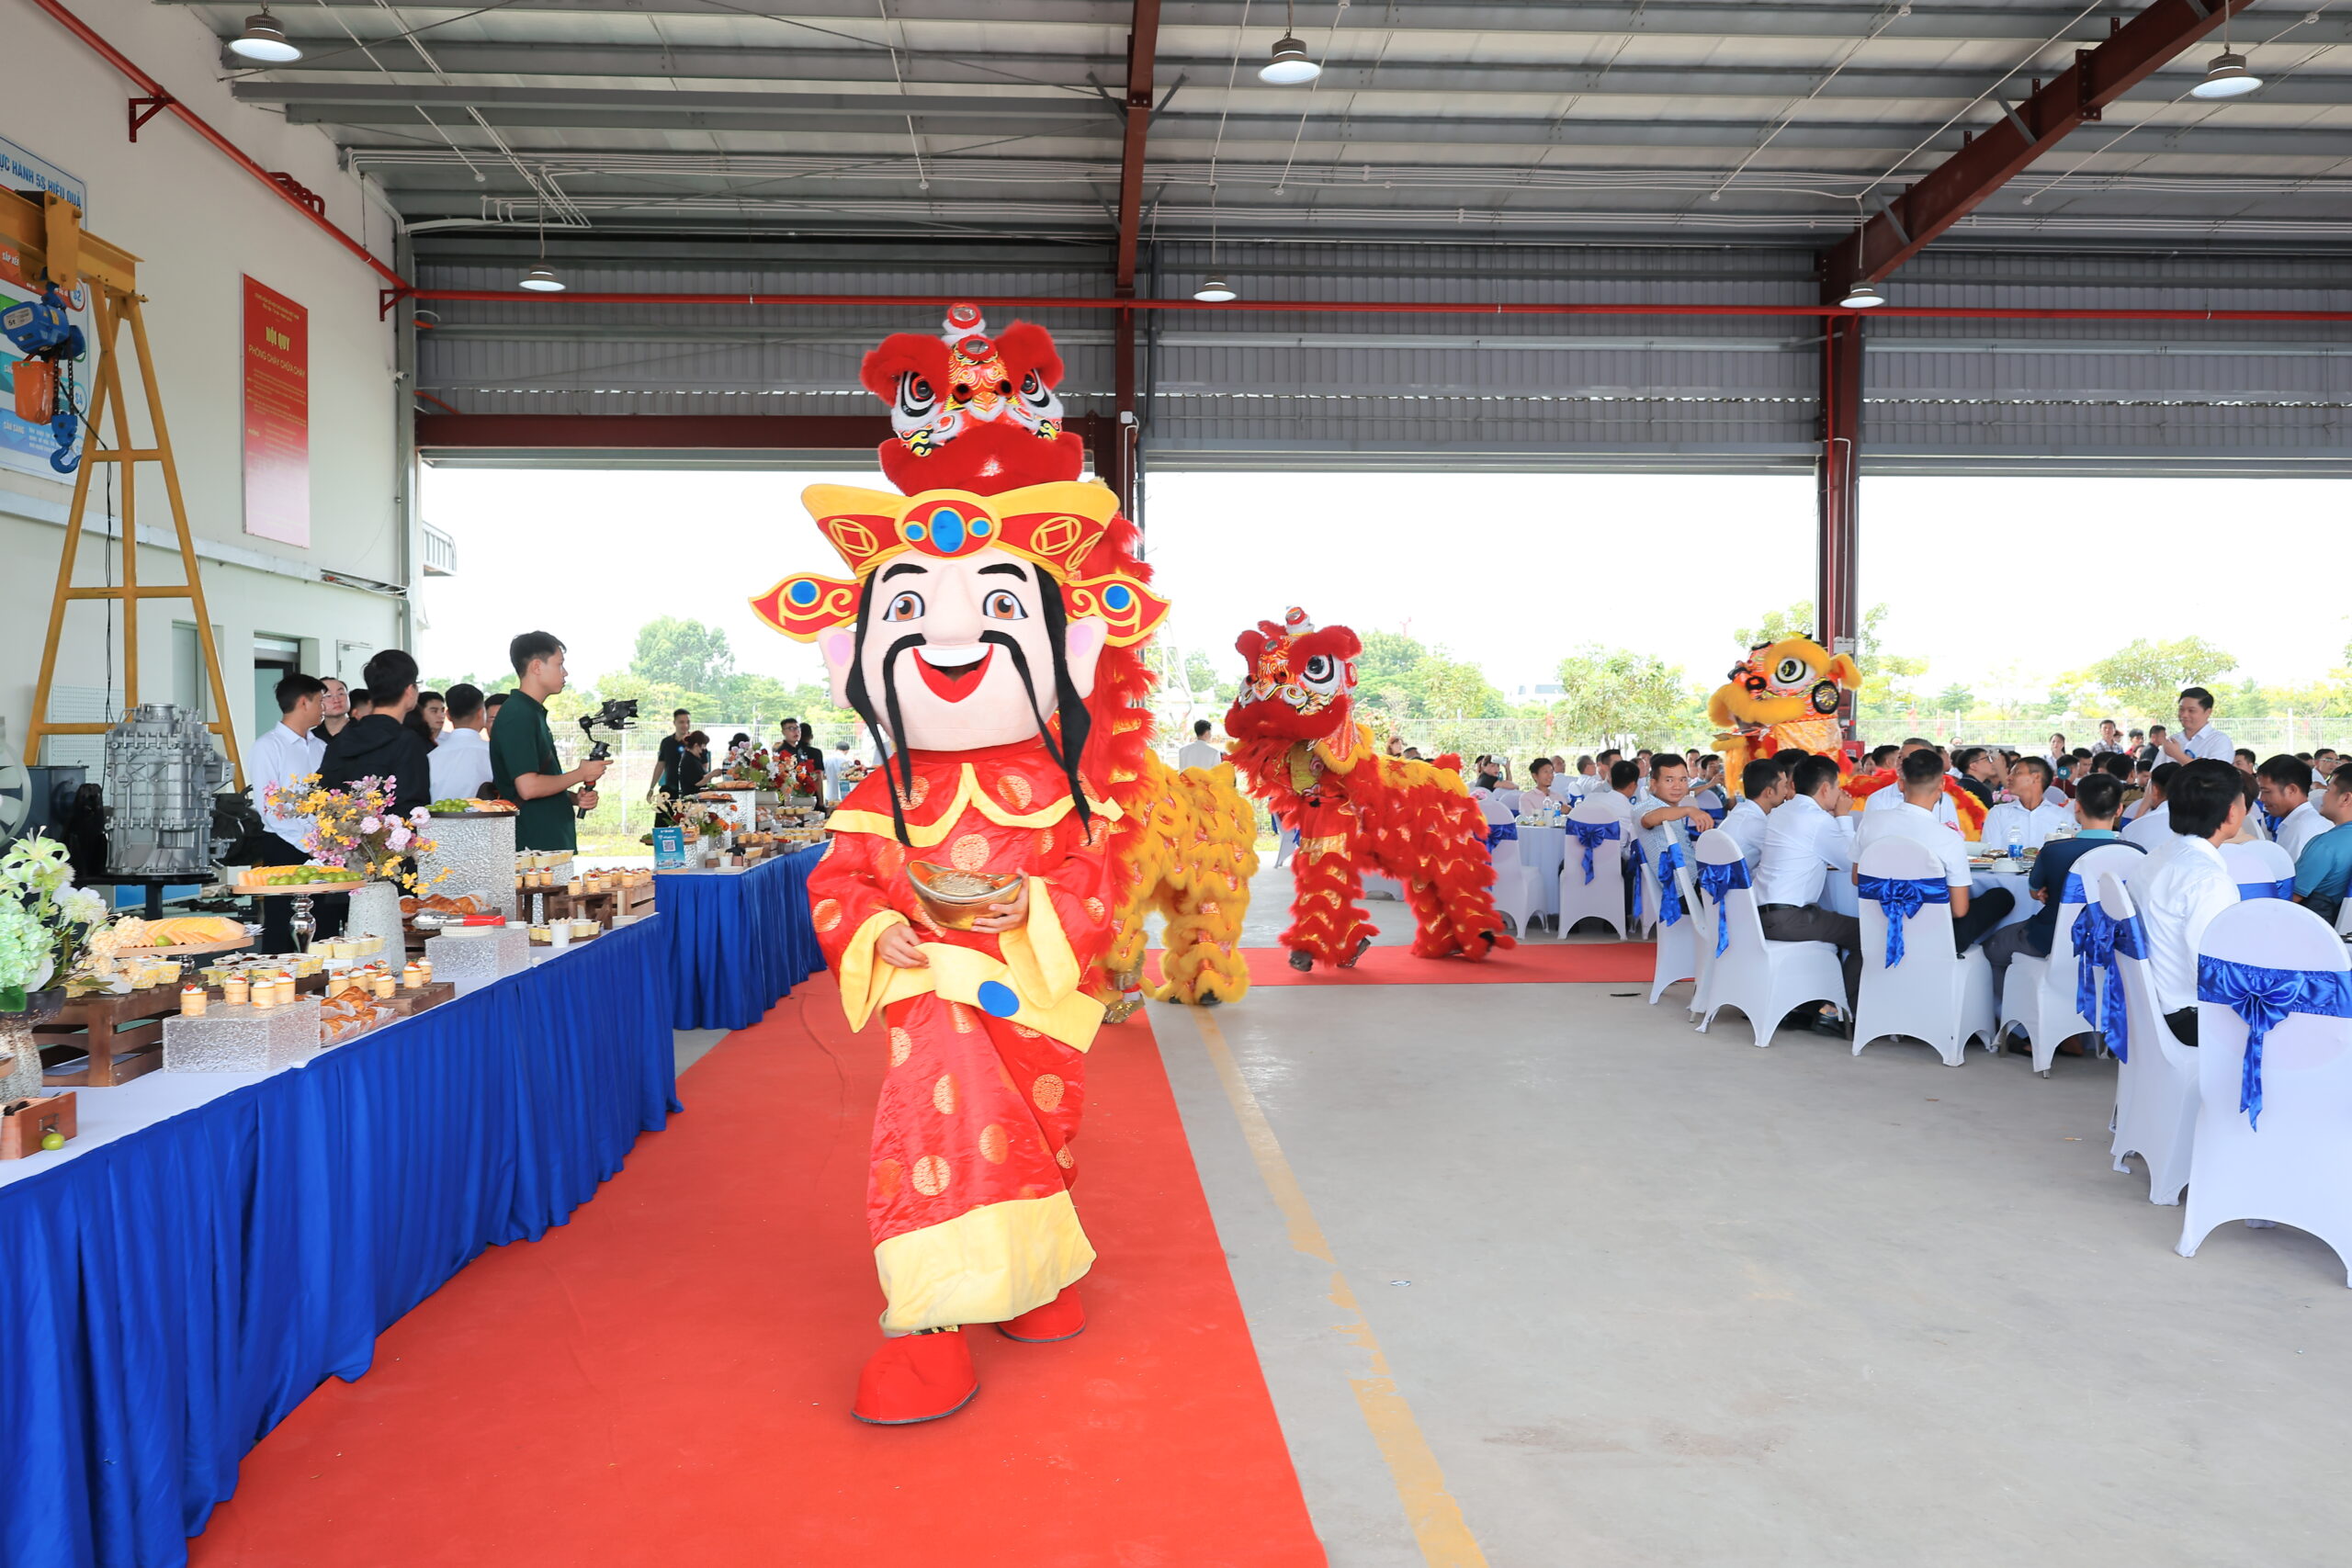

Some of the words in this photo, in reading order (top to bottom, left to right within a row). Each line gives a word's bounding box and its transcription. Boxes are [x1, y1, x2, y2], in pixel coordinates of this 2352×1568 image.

[12, 161, 33, 184] HÀNH
[36, 174, 46, 189] 5S
[248, 344, 267, 360] PHÒNG
[278, 332, 290, 352] QUY
